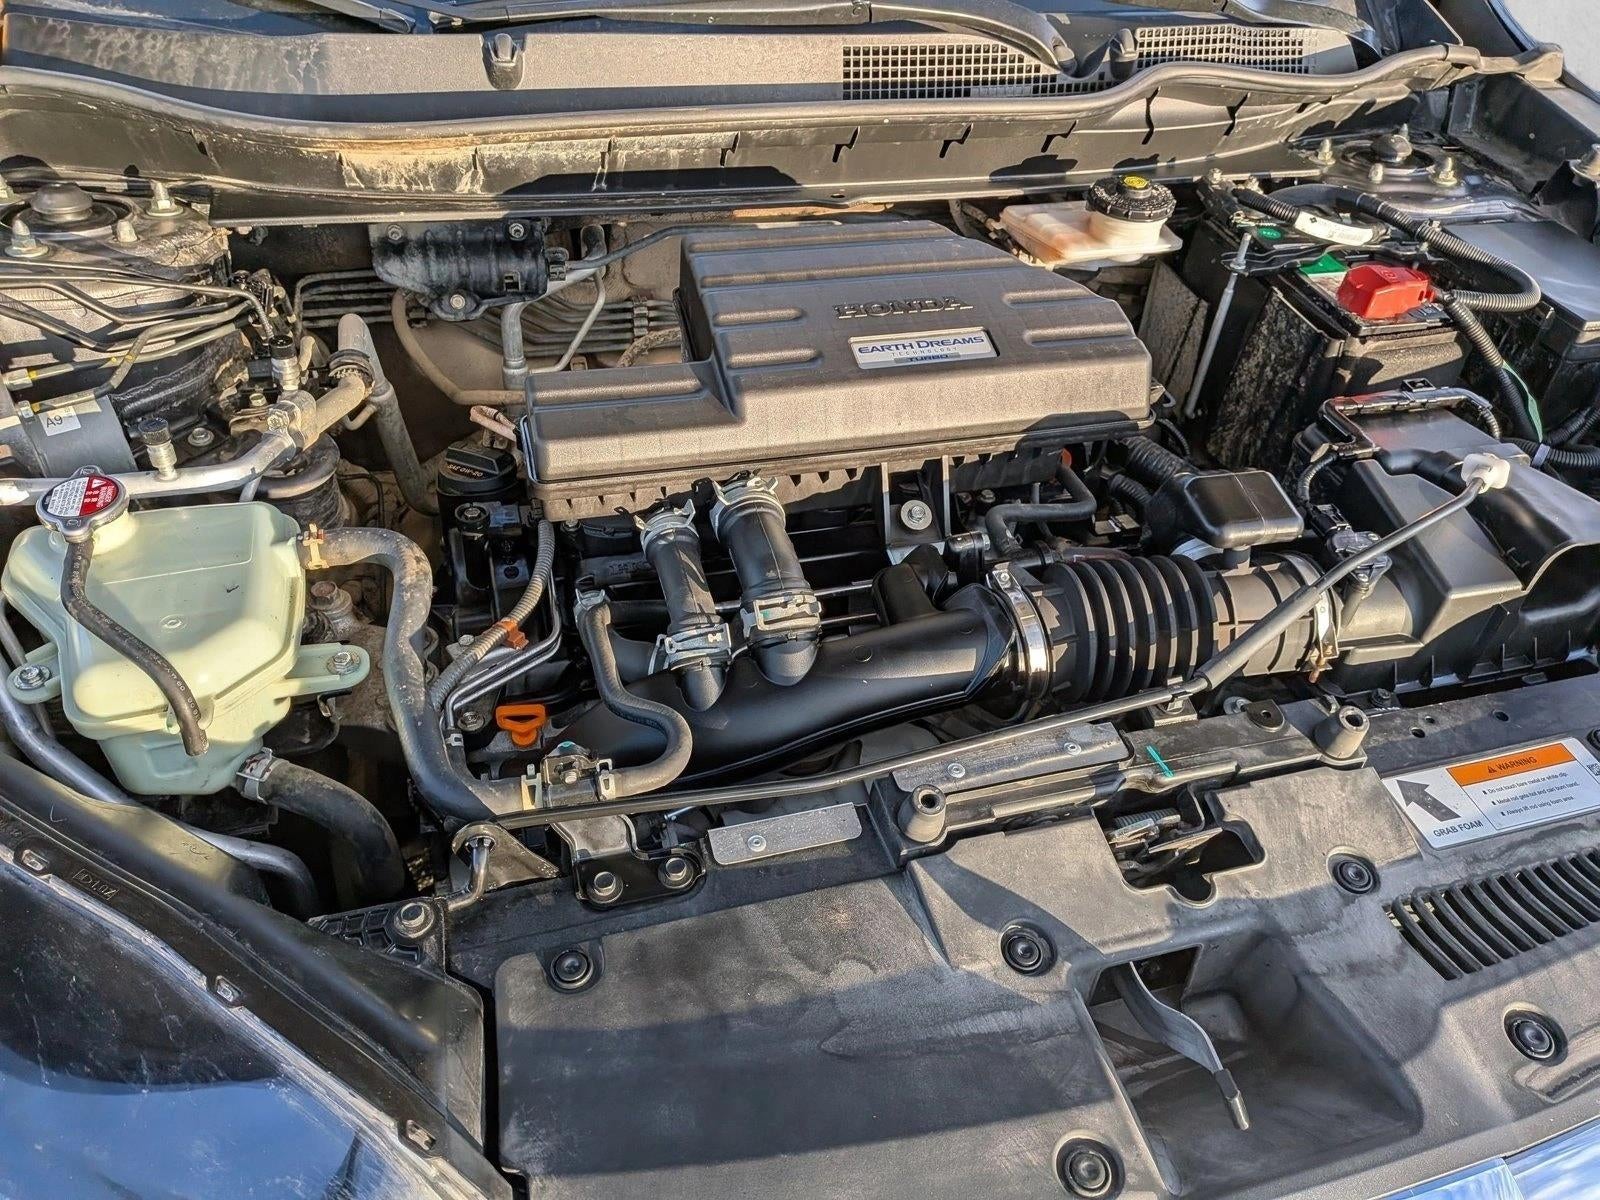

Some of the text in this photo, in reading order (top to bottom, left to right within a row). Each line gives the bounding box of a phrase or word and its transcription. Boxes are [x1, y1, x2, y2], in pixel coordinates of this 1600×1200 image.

[834, 296, 973, 319] HONDA
[858, 336, 984, 354] EARTH DREAMS
[891, 347, 957, 357] TECHNOLOGY
[908, 354, 949, 362] TURBO
[46, 415, 63, 428] A9
[1495, 756, 1538, 771] WARNING
[1433, 820, 1484, 838] GRAB FOAM
